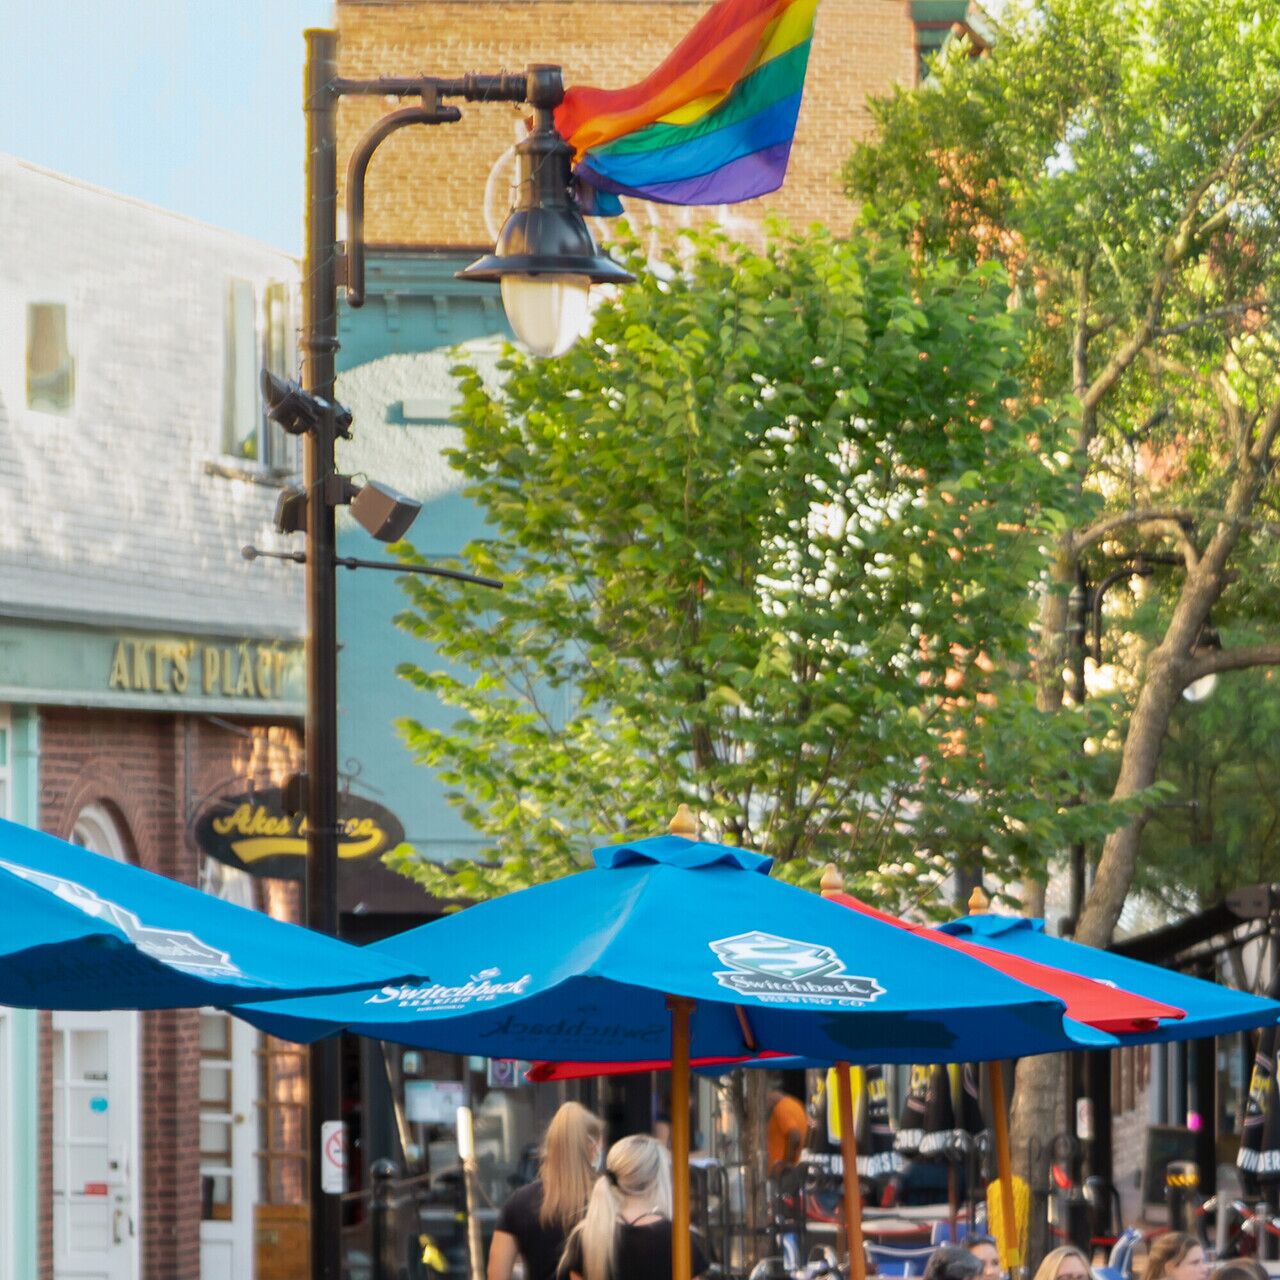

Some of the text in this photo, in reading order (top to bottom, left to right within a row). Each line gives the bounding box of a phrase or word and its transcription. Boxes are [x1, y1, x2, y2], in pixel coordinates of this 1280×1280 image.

[109, 639, 194, 693] AKES'
[364, 974, 532, 1005] Switchback
[729, 975, 870, 995] Switchback
